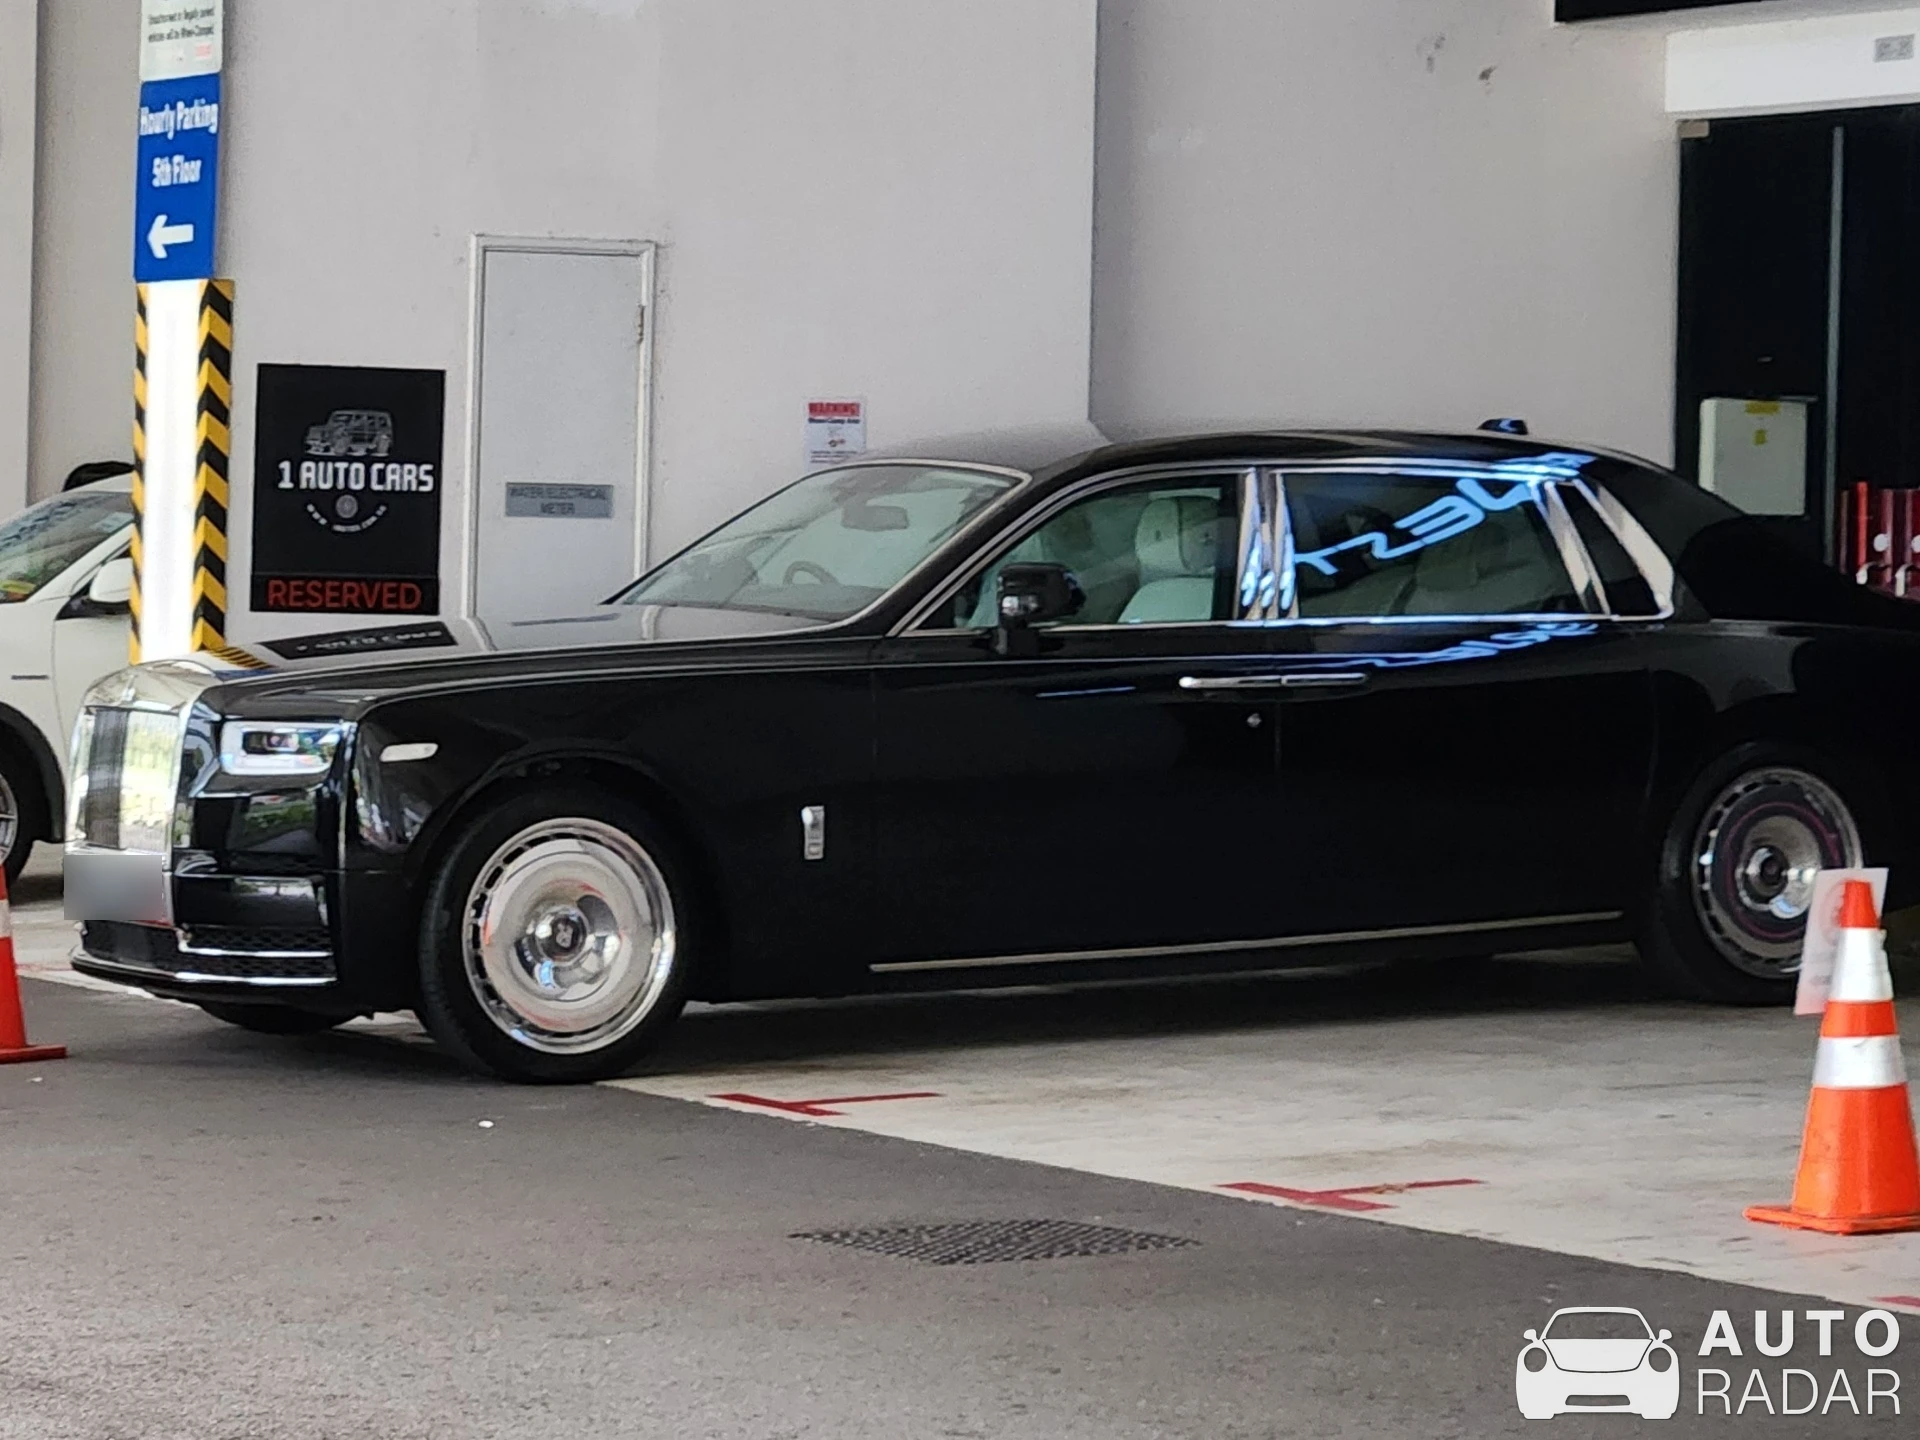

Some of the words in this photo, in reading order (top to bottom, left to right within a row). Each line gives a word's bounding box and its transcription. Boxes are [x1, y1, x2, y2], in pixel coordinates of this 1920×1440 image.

[140, 103, 175, 140] Hourly
[177, 98, 218, 134] Parking
[152, 156, 172, 187] 5th
[172, 154, 202, 185] Floor
[278, 460, 294, 489] 1
[299, 461, 366, 490] AUTO
[369, 463, 434, 492] CARS
[268, 579, 423, 609] RESERVED
